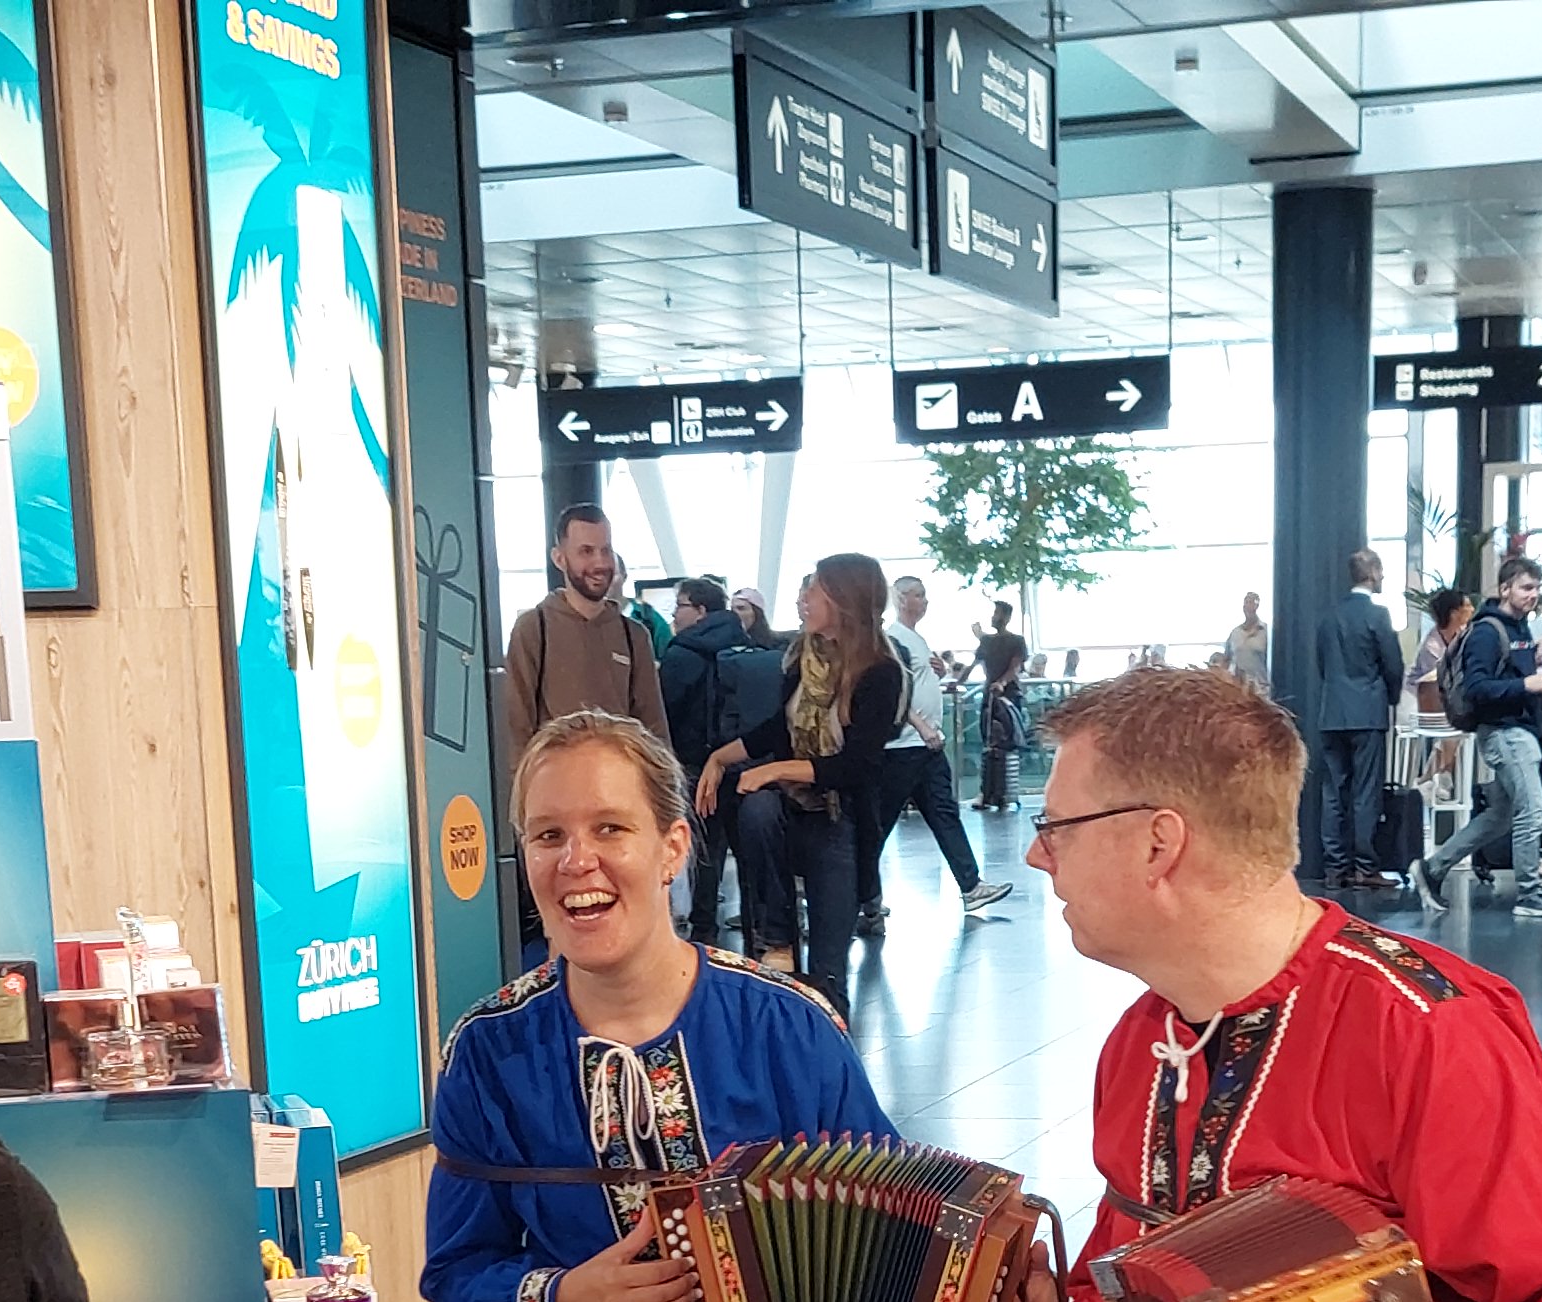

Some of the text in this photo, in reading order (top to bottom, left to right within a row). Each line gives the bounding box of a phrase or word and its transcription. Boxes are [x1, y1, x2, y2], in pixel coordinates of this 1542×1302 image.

[247, 9, 340, 79] SAVINGS
[1419, 366, 1494, 381] Restaurants
[1419, 383, 1479, 397] Shopping
[966, 381, 1043, 424] Gates A
[449, 825, 477, 843] SHOP
[450, 847, 479, 870] NOW
[296, 935, 377, 987] ZÜRICH
